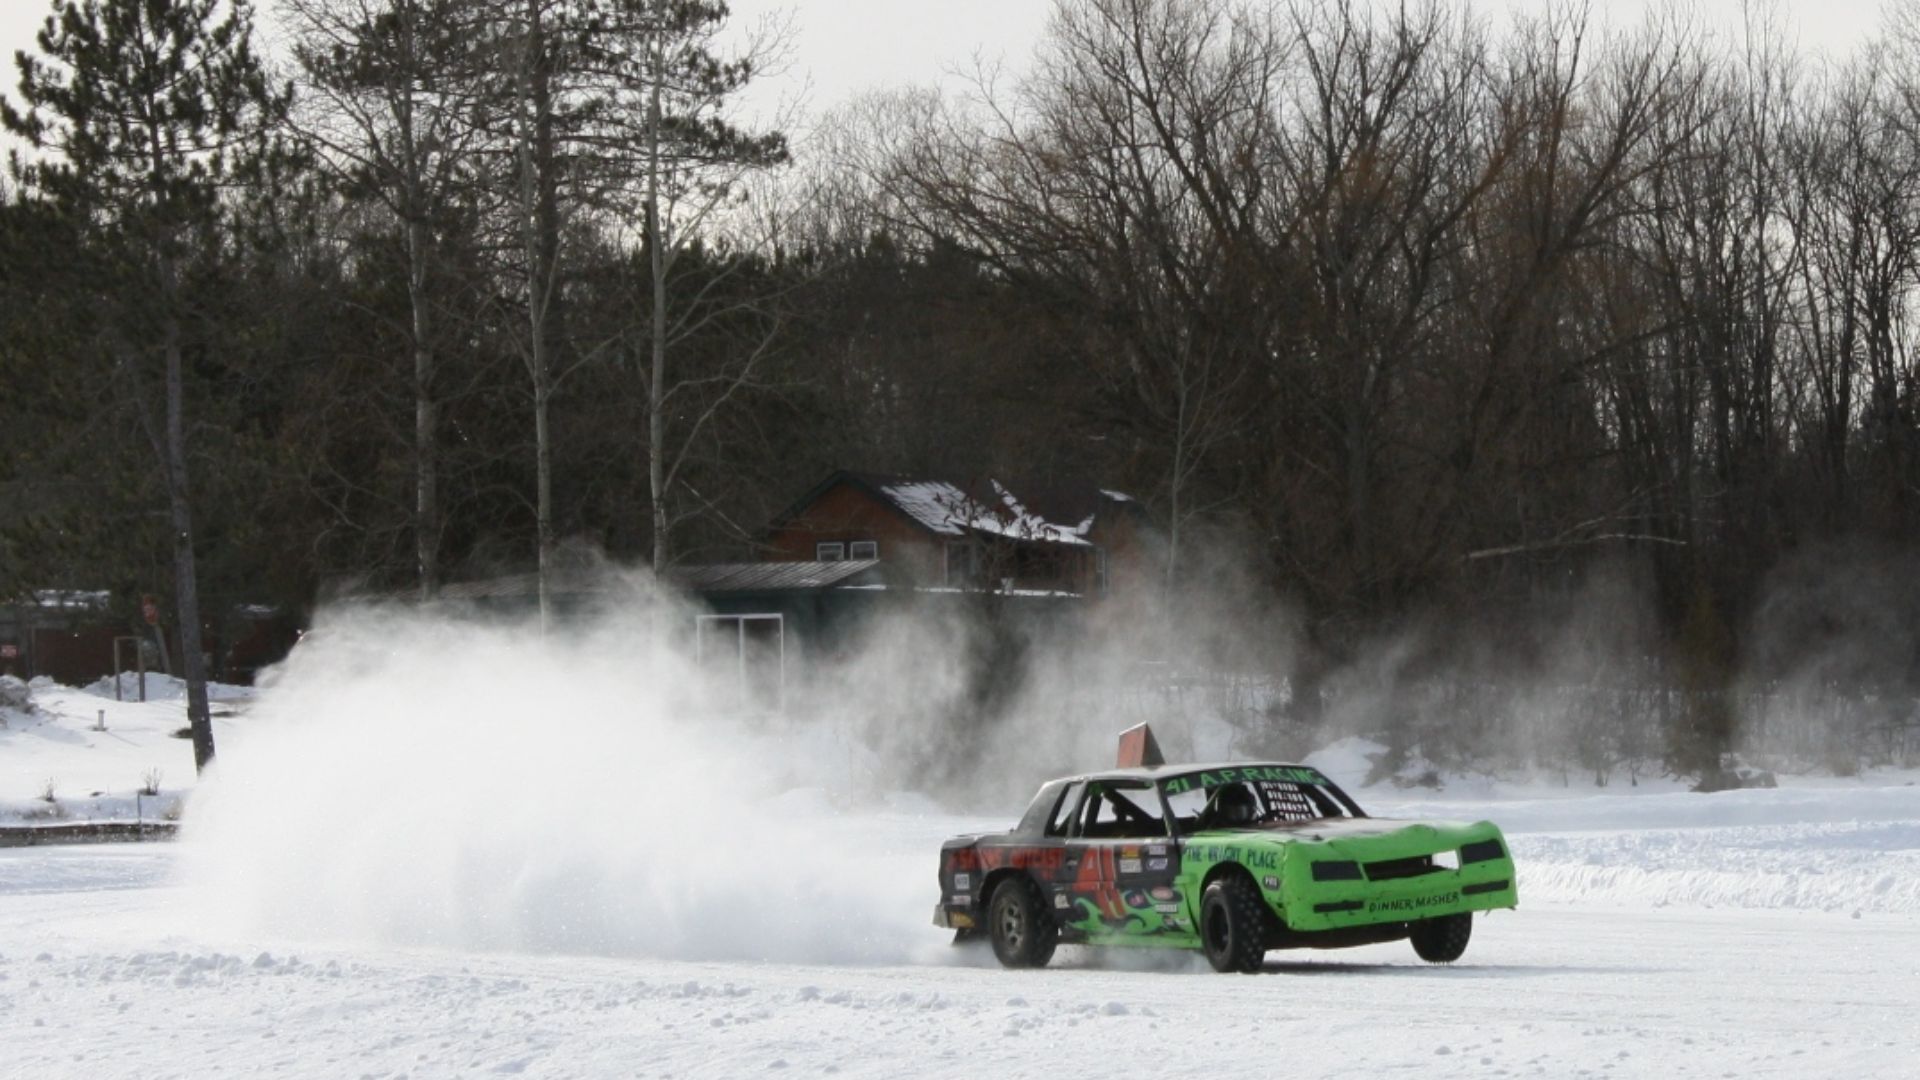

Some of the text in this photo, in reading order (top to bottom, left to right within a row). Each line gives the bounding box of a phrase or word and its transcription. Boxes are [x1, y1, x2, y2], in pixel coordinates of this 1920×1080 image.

[1165, 779, 1190, 793] 41
[1247, 848, 1277, 869] PLACE
[1369, 891, 1459, 913] DINNER MASHER
